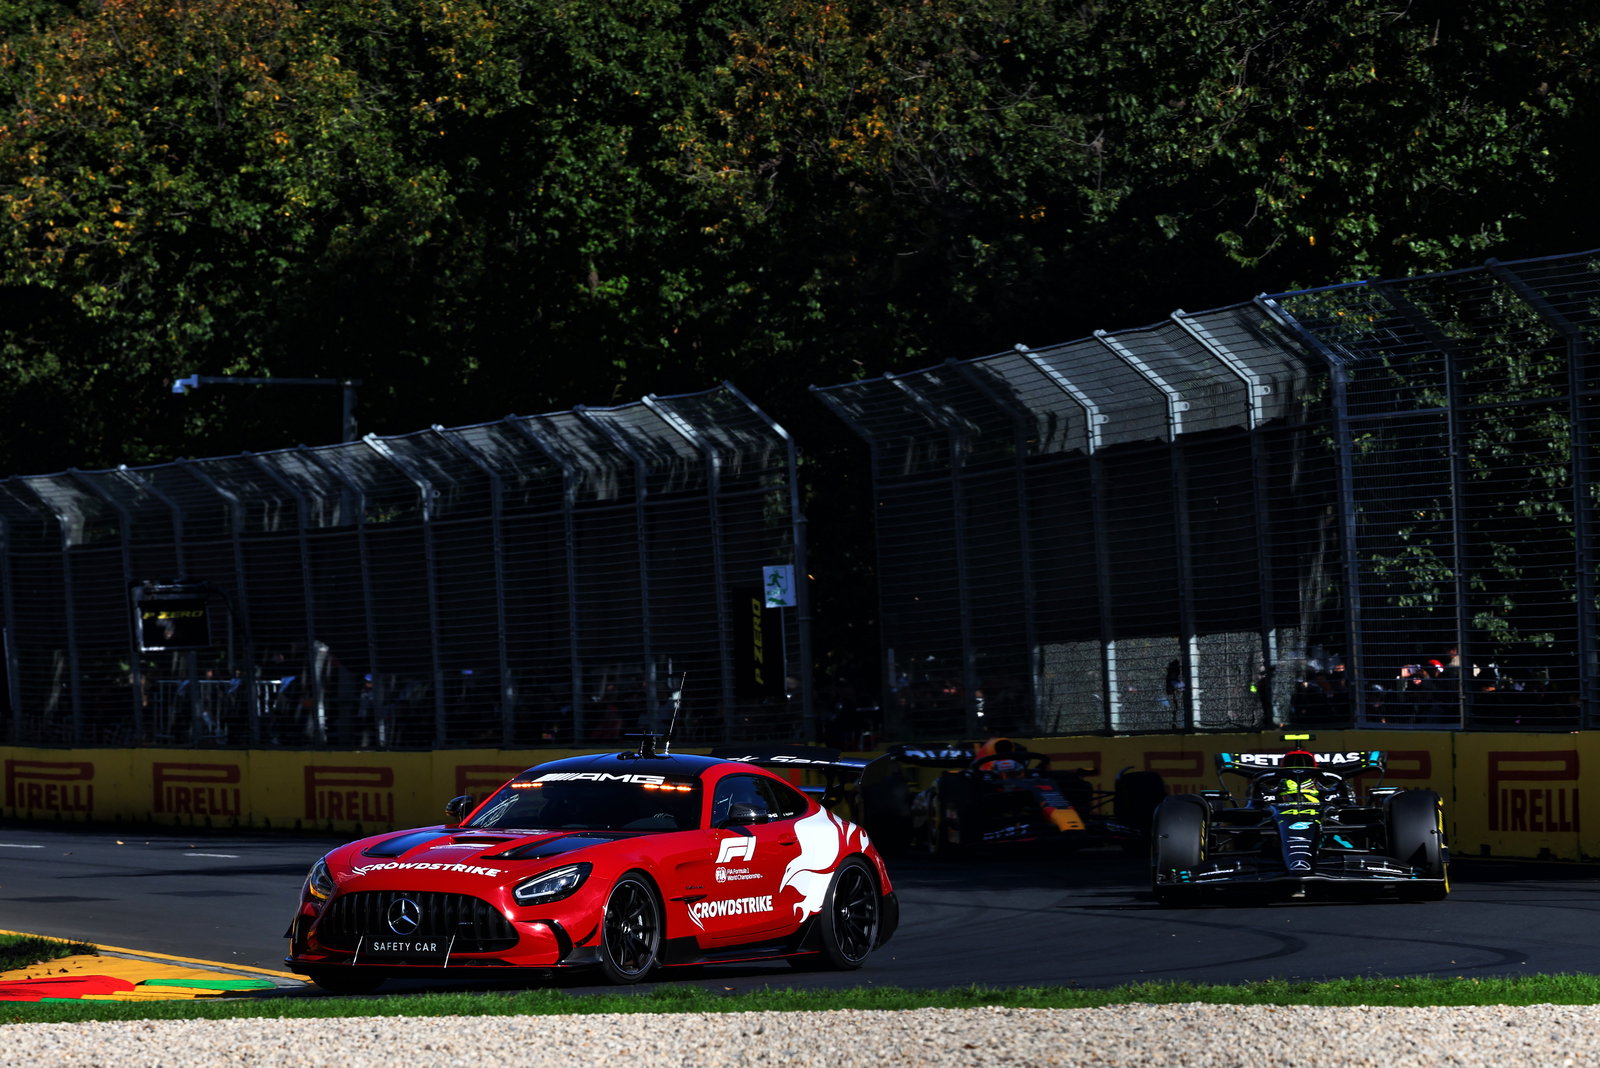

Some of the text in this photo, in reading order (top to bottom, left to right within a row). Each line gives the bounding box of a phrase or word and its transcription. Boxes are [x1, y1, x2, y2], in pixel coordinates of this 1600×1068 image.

[751, 597, 764, 664] ZERO
[1240, 752, 1361, 765] PETNAS
[5, 760, 94, 812] PIRELLI
[153, 762, 240, 816] PIRELLI
[564, 773, 665, 785] AMG
[1488, 750, 1579, 832] PIRELLI
[304, 766, 394, 822] PIRELLI
[1279, 808, 1320, 816] 44
[715, 836, 757, 864] F1
[359, 862, 501, 878] CROWDSTRIKE
[691, 895, 774, 919] CROWDSTRIKE
[373, 941, 437, 952] SAFETY CAR
